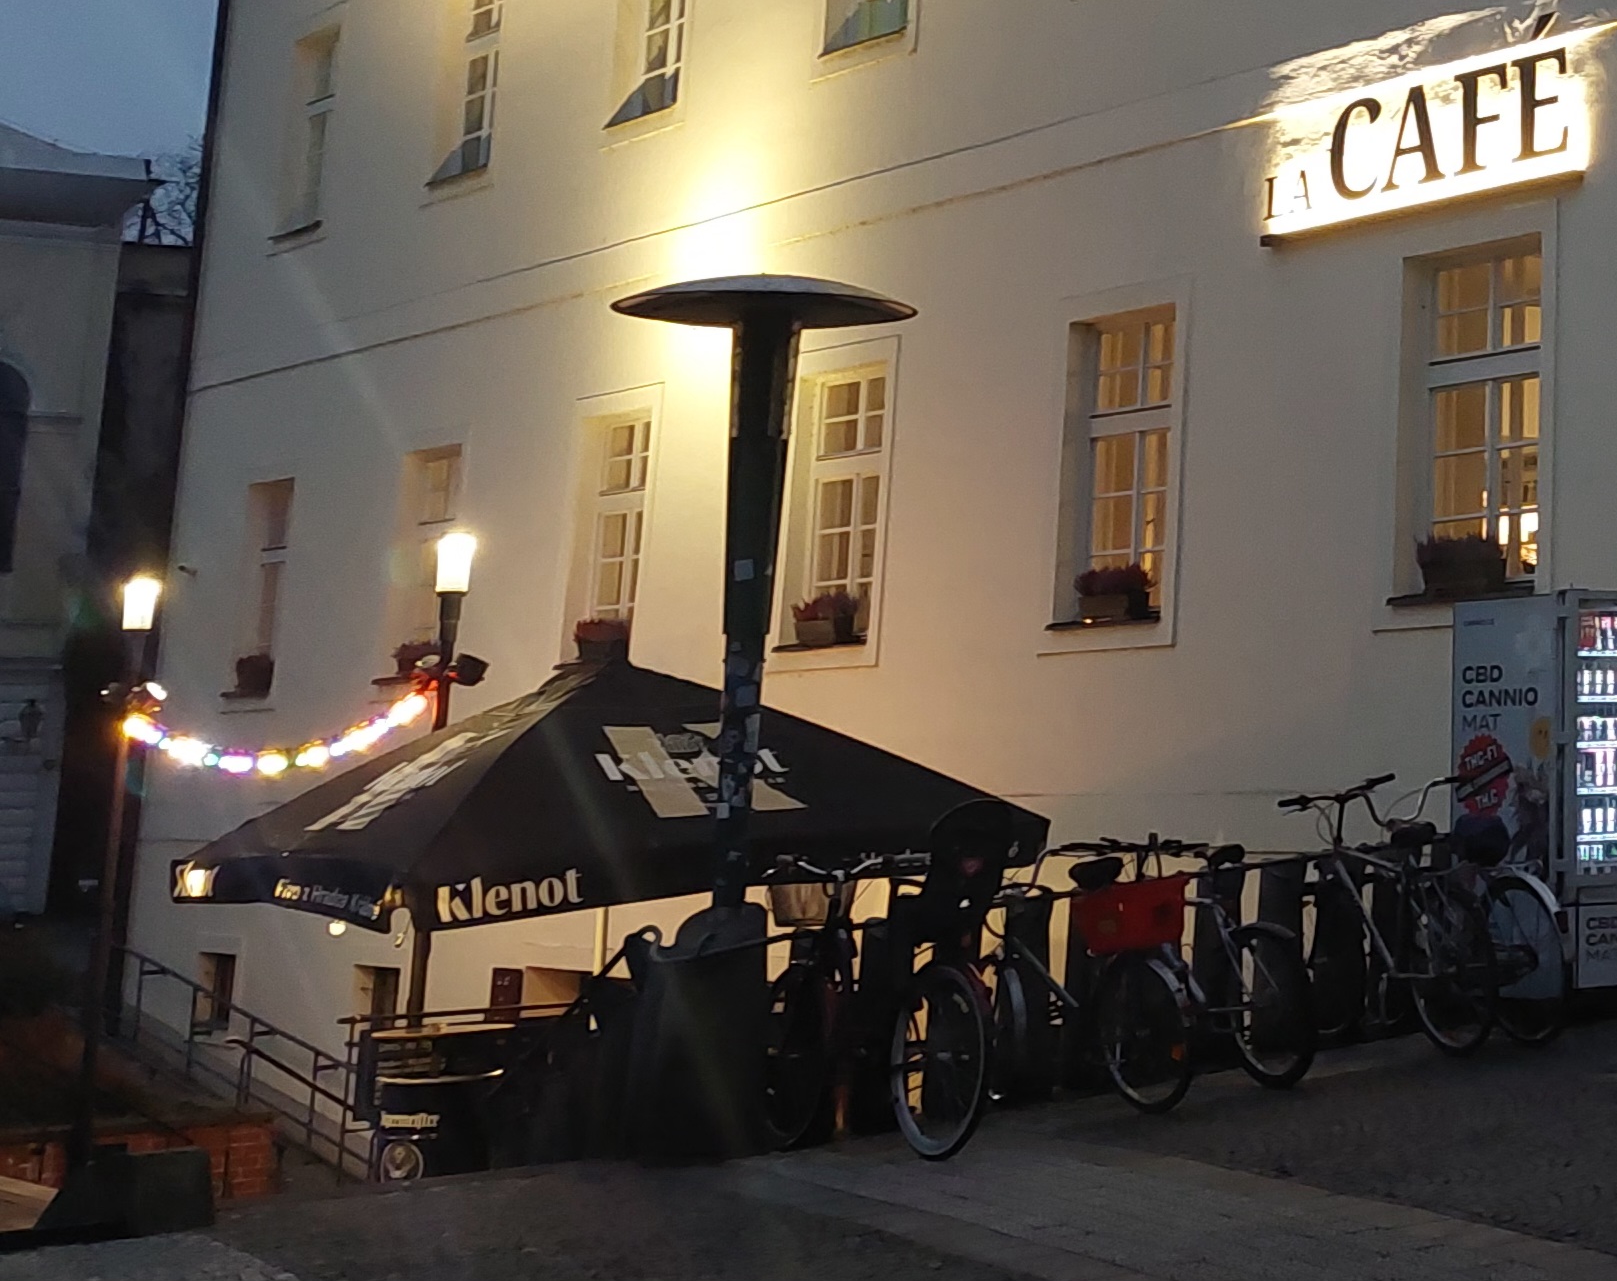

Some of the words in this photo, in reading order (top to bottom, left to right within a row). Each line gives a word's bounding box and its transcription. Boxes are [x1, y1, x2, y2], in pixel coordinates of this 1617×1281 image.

[1262, 170, 1313, 222] LA
[1461, 664, 1504, 685] CBD
[1461, 686, 1539, 711] CANNIO
[1461, 712, 1502, 732] MAT
[437, 866, 585, 924] Klenot
